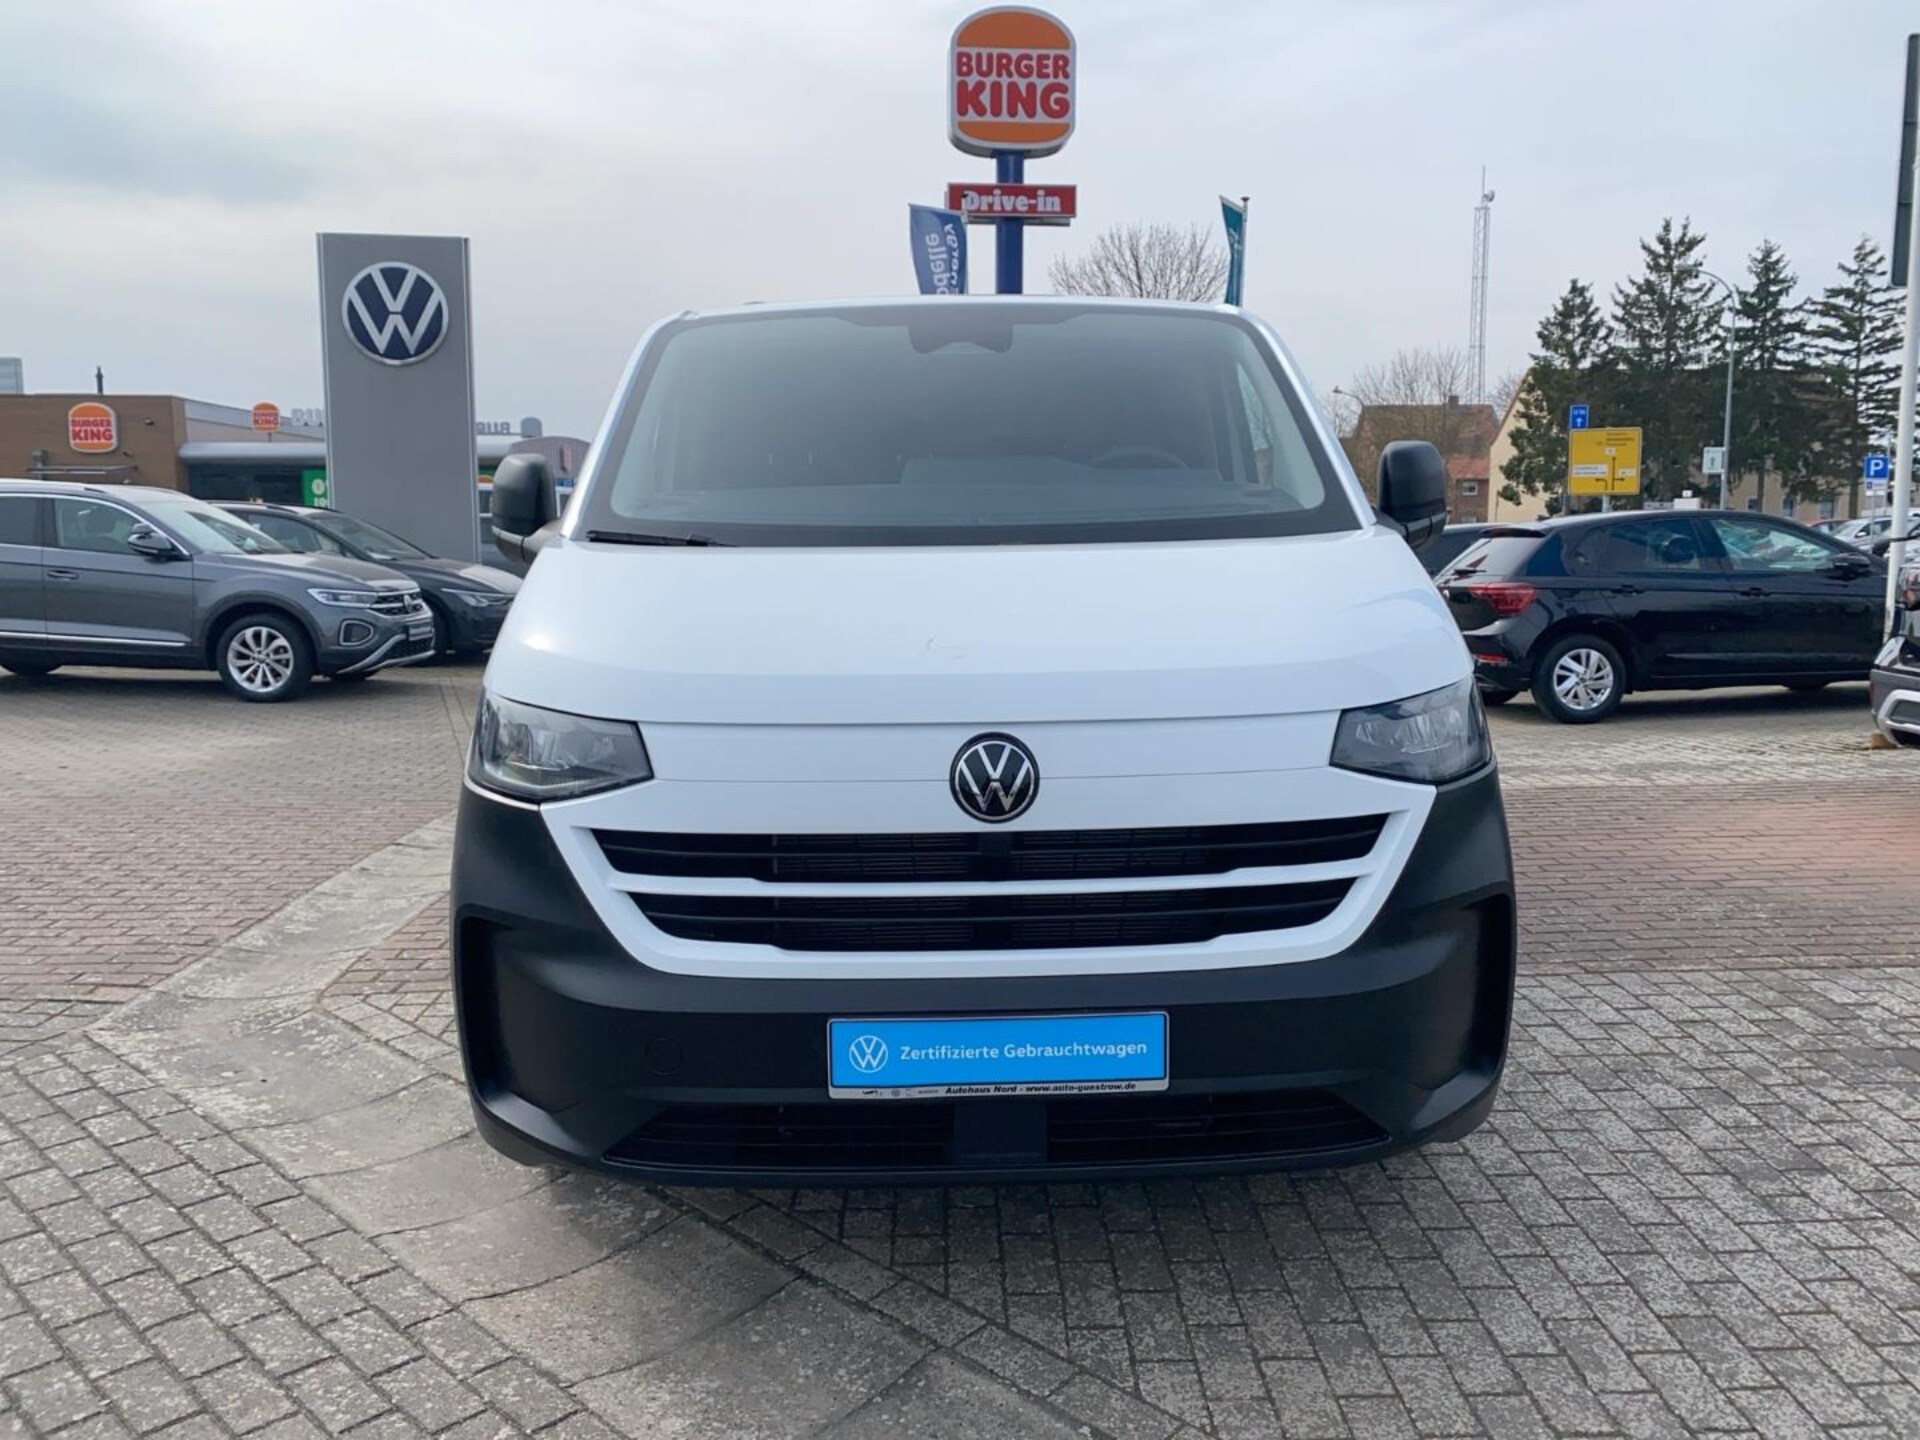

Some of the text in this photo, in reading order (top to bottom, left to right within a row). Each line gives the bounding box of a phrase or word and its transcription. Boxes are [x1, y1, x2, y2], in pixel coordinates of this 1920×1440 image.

[956, 51, 1070, 79] BURGER
[956, 79, 1071, 119] KING
[963, 188, 1061, 212] Drive-in
[71, 428, 113, 441] KING
[1870, 459, 1884, 476] P
[900, 1042, 1147, 1060] Zertifizierte Gebrauchtwagen
[945, 1086, 991, 1095] Autohaus
[994, 1085, 1017, 1093] Nord
[1026, 1082, 1136, 1093] www.auto-guestrow.de
